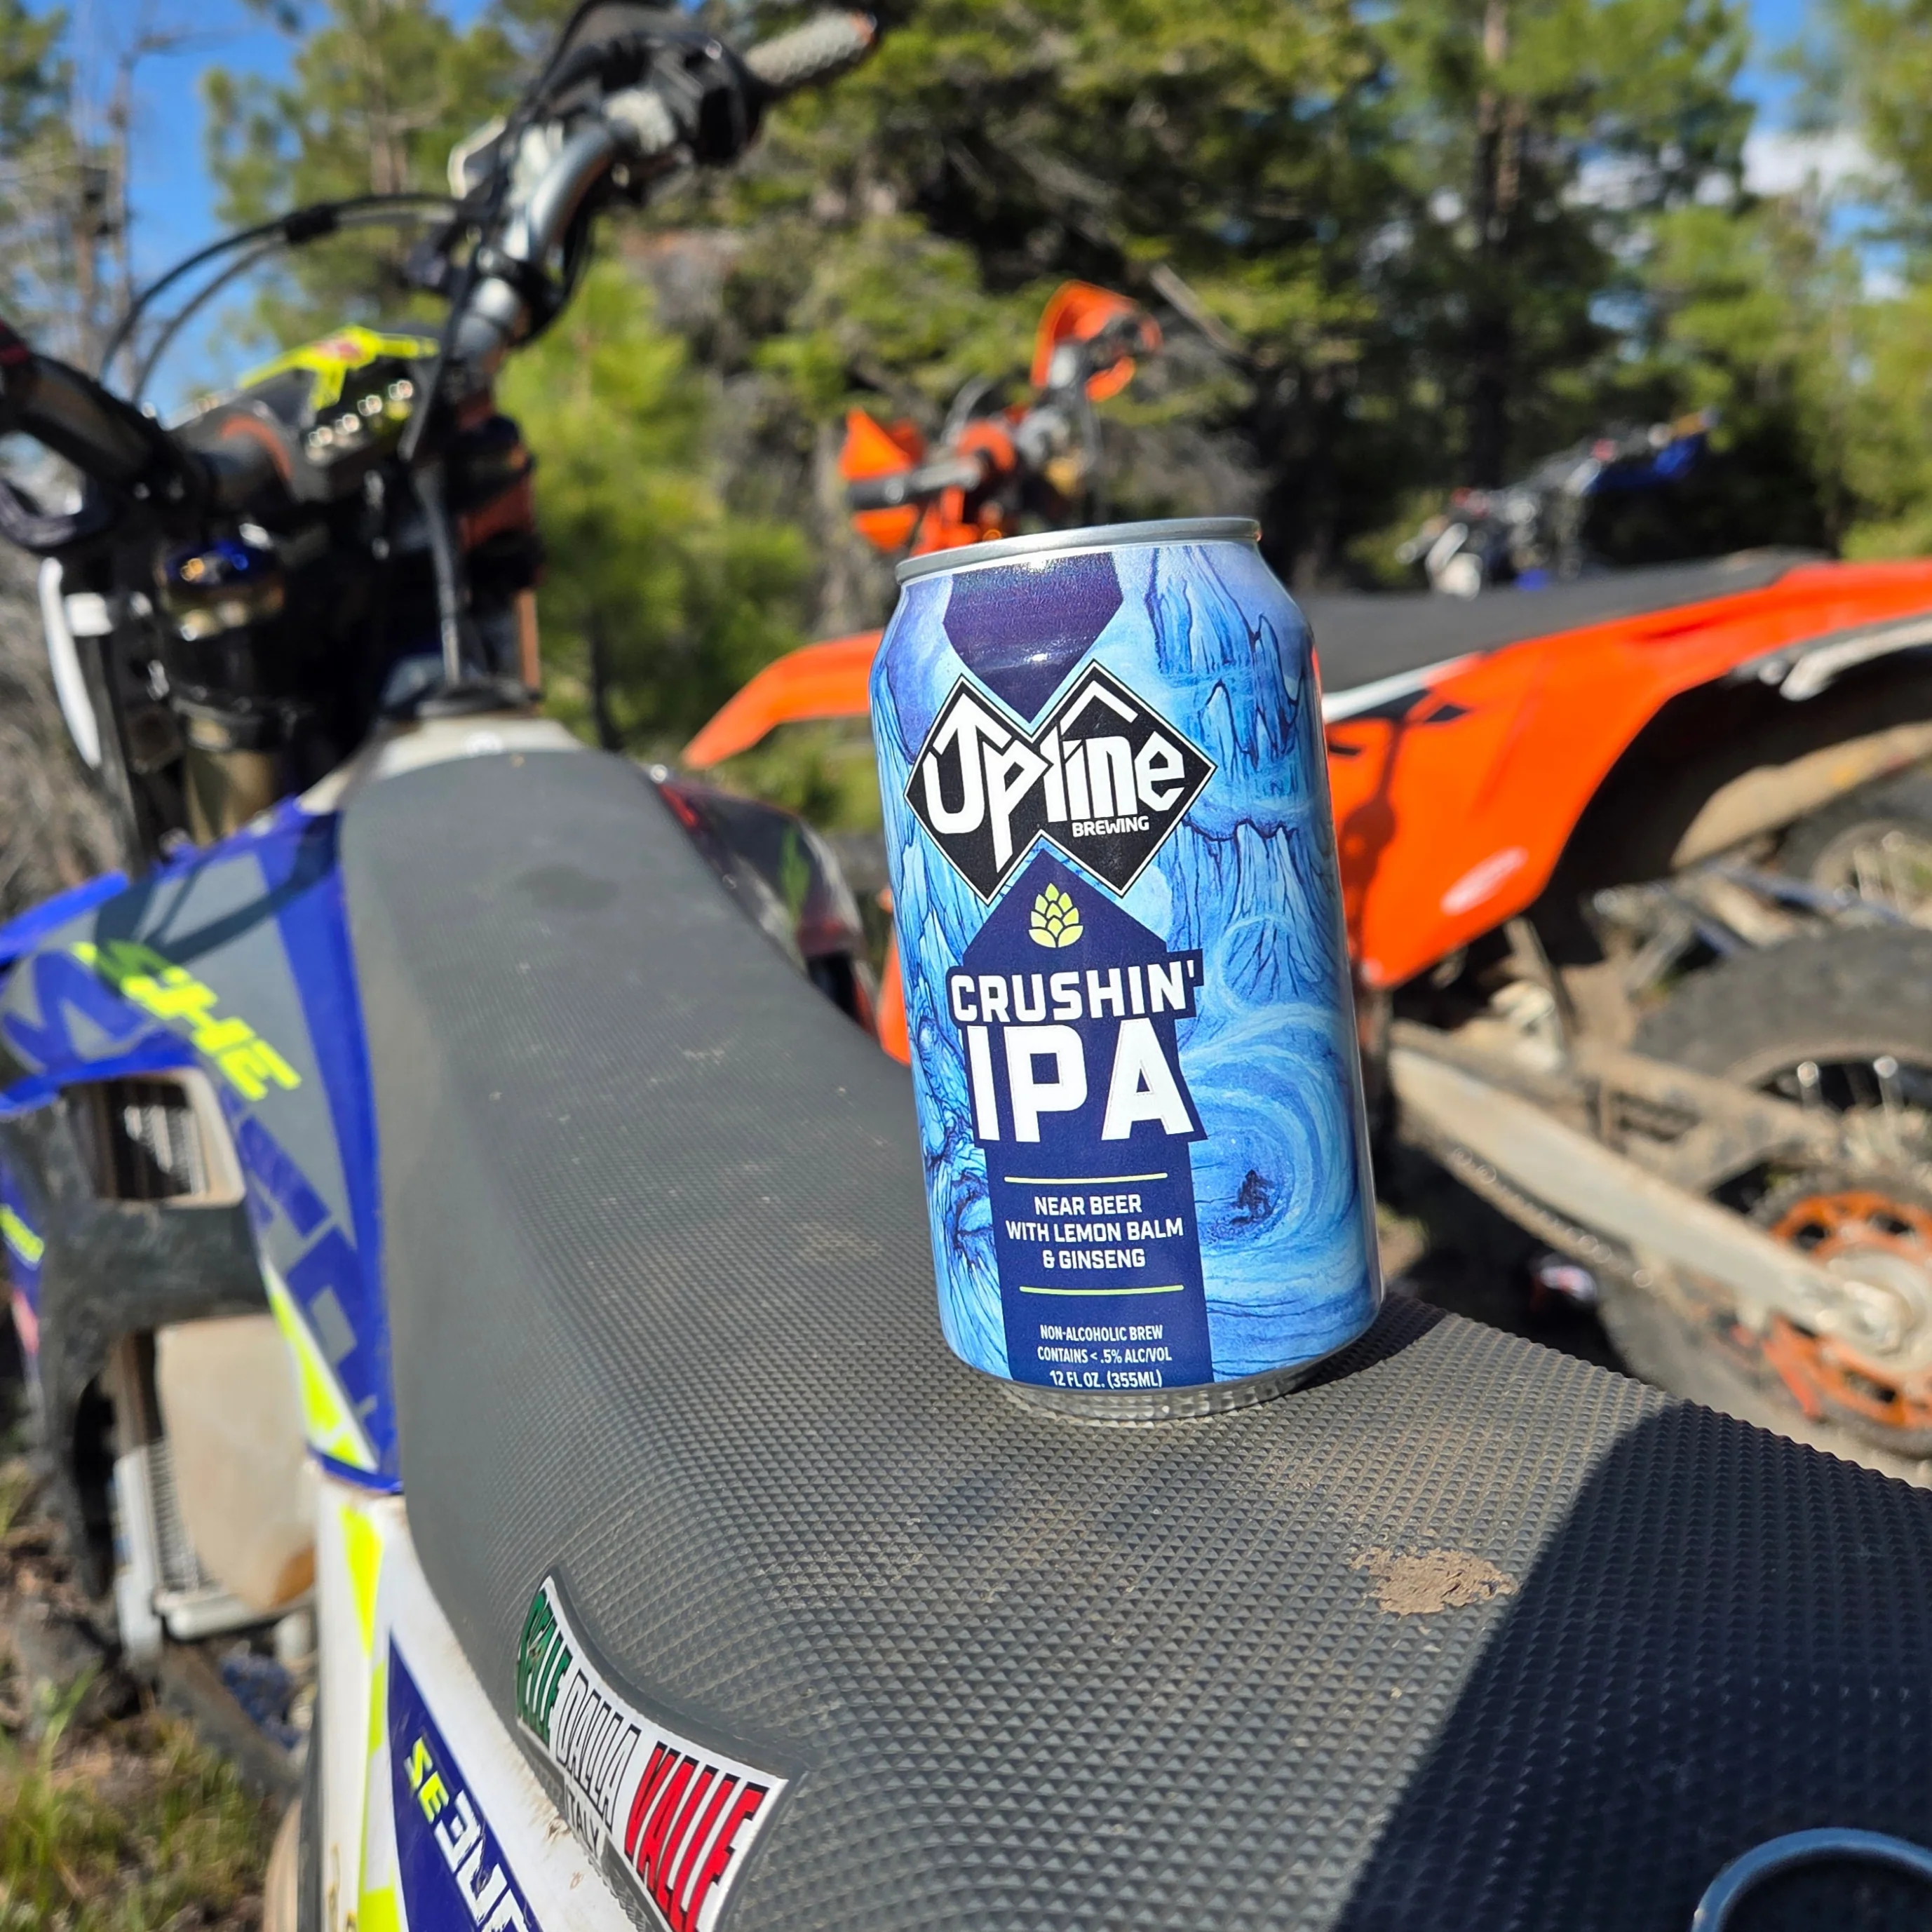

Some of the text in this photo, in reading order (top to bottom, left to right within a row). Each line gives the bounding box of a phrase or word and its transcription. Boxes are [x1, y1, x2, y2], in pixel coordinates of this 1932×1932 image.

[1072, 815, 1150, 838] BREWING
[951, 959, 1195, 1023] CRUSHIN'
[967, 1018, 1194, 1143] IPA
[1034, 1194, 1142, 1216] NEAR BEER
[1006, 1217, 1184, 1243] WITH LEMON BALM
[1042, 1248, 1146, 1270] & GINSENG
[1040, 1324, 1163, 1342] NON-ALCOHOLIC BREW
[1037, 1346, 1088, 1364] CONTAINS
[1100, 1349, 1122, 1364] .5%
[1124, 1346, 1173, 1363] ALC/VOL
[1049, 1370, 1163, 1390] 12 FL OZ. (355ML)
[404, 1736, 450, 1825] SE
[556, 1668, 642, 1835] DALLA
[624, 1741, 770, 1932] VALLE
